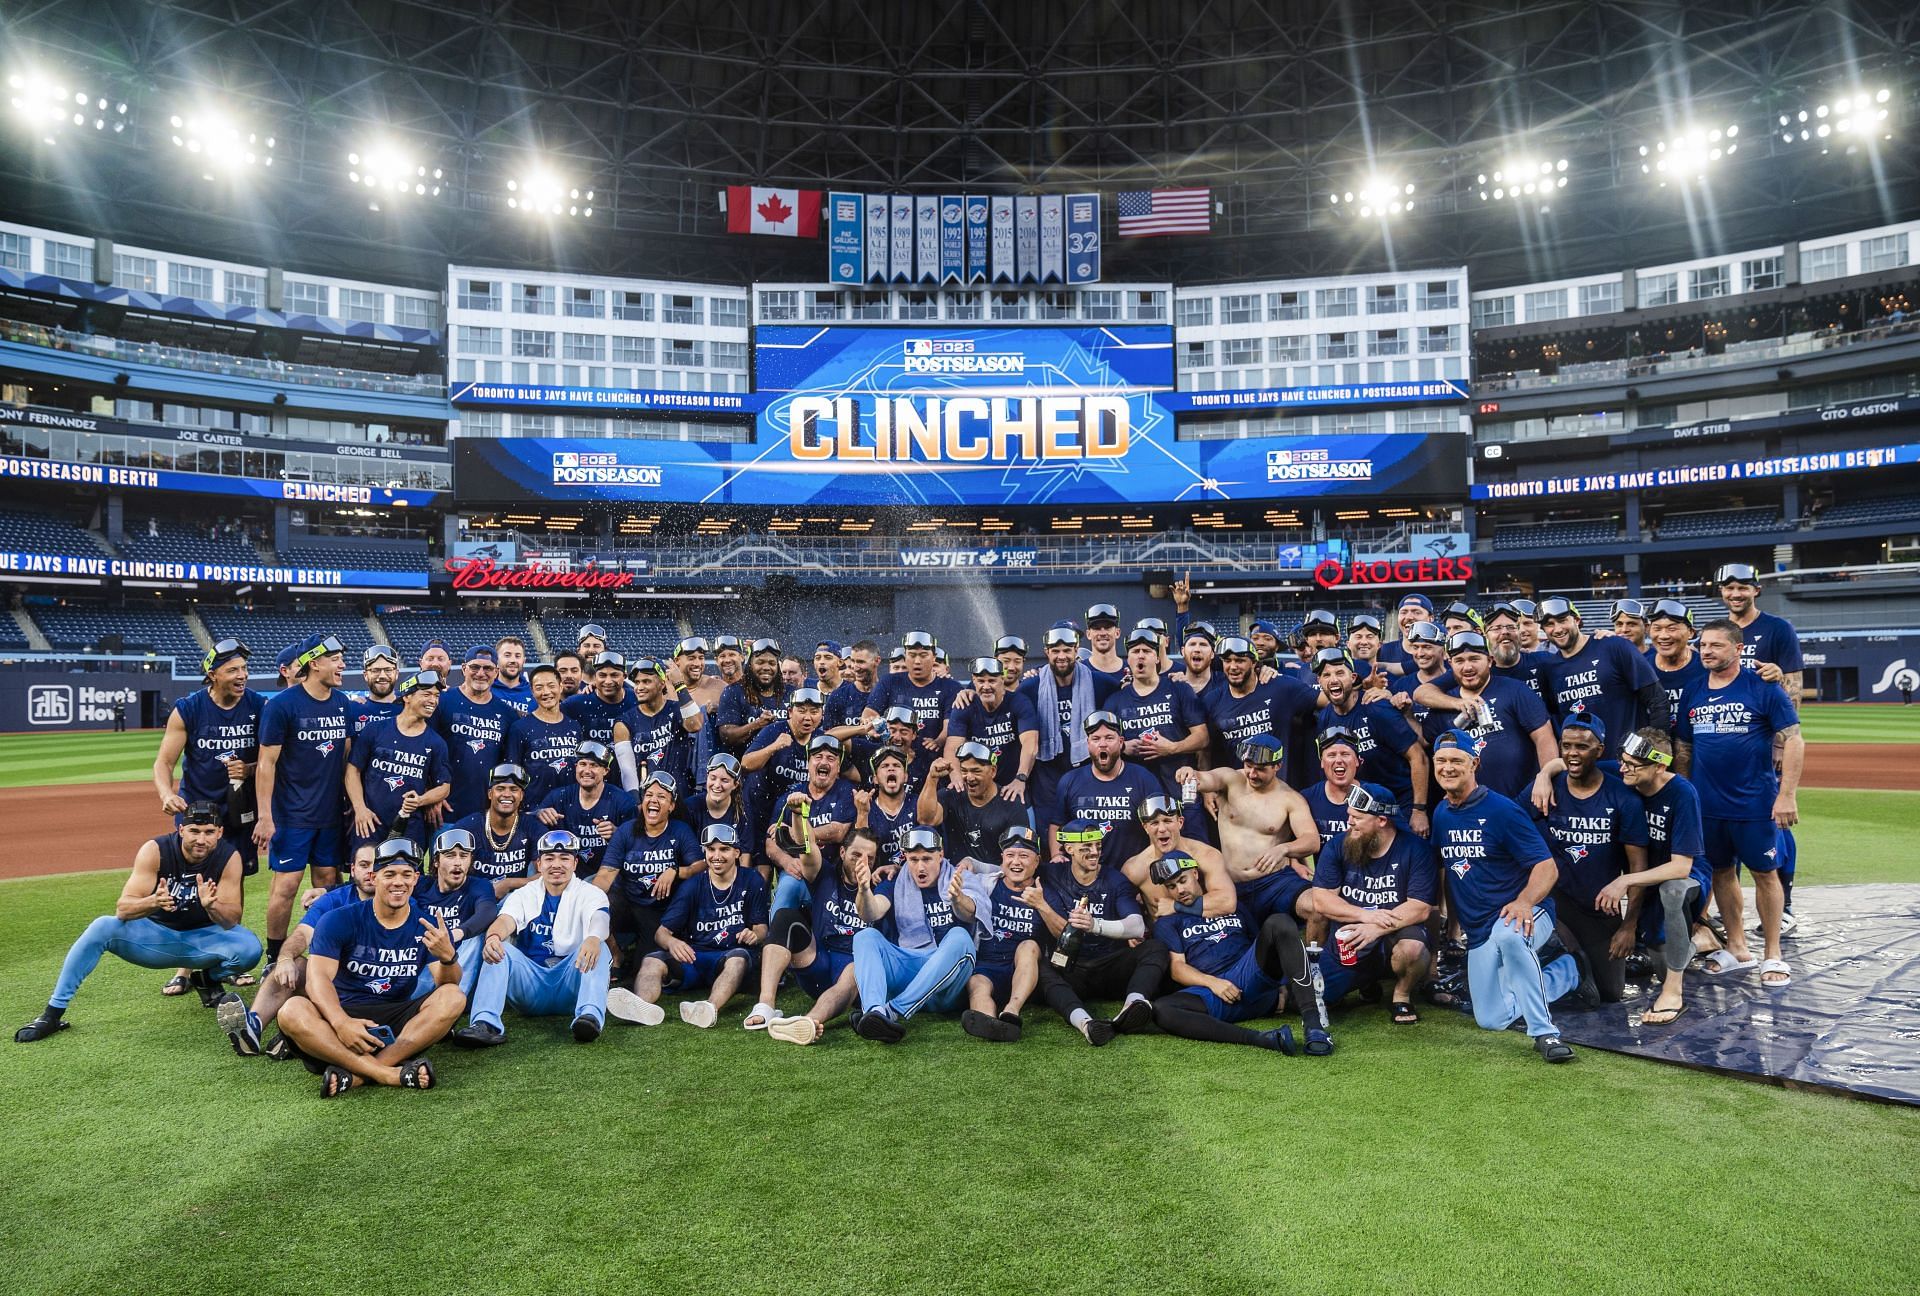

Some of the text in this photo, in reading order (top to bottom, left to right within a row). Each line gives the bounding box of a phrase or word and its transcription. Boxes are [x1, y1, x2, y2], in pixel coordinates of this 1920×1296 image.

[869, 226, 886, 238] 1985
[894, 227, 910, 238] 1989
[920, 228, 936, 239] 1991
[944, 228, 961, 239] 1992
[994, 227, 1012, 239] 2015
[1019, 227, 1036, 239] 2016
[1068, 232, 1098, 254] 32
[933, 342, 975, 352] 2023
[904, 356, 1024, 372] POSTSEASON
[472, 387, 742, 407] TORONTO BLUE JAYS HAVE CLINCHED A POSTSEASON BERTH
[1192, 384, 1452, 405] TORONTO BLUE JAYS HAVE CLINCHED A POSTSEASON BERTH
[1822, 402, 1899, 421] CITO GASTON
[29, 413, 97, 430] FERNANDEZ
[790, 396, 1129, 460] CLINCHED
[1674, 424, 1731, 438] DAVE STIEB
[177, 431, 242, 446] JOE CARTER
[337, 446, 401, 458] GEORGE BELL
[1292, 451, 1328, 461] 2023
[579, 456, 617, 465] 2023
[0, 459, 158, 486] POSTSEASON BERTH
[554, 467, 661, 483] POSTSEASON
[1268, 463, 1373, 479] POSTSEASON
[1488, 482, 1543, 497] TORONTO
[1548, 478, 1580, 493] BLUE
[1584, 476, 1615, 490] JAYS
[1620, 473, 1653, 488] HAVE
[1659, 466, 1726, 485] CLINCHED
[1731, 464, 1740, 478] A
[1746, 454, 1840, 476] POSTSEASON
[283, 482, 371, 504] CLINCHED
[901, 550, 1036, 567] WESTJET FLIGHT
[1007, 559, 1032, 567] DECK
[0, 554, 341, 584] UE JAYS HAVE CLINCHED A POSTSEASON BERTH
[445, 557, 633, 589] Budweiser
[1352, 556, 1472, 583] ROGERS
[1741, 644, 1756, 656] KE
[1565, 670, 1597, 687] TAKE
[79, 687, 137, 703] Here's
[1557, 684, 1603, 704] CTOBER
[912, 698, 938, 707] TAKE
[1137, 702, 1170, 716] TAKE
[1696, 703, 1744, 715] TORONTO
[772, 710, 787, 718] KE
[916, 709, 940, 719] OBER
[1237, 710, 1270, 726] TAKE
[1716, 712, 1752, 724] JAYS
[318, 716, 345, 727] TAKE
[471, 716, 501, 730] TAKE
[1122, 714, 1173, 730] OCTOBER
[219, 725, 254, 737] TAKE
[298, 728, 346, 740] OCTOBER
[451, 724, 501, 742] OCTOBER
[1354, 727, 1371, 739] KE
[1468, 721, 1504, 738] OBER
[197, 738, 255, 749] OCTOBER
[549, 737, 577, 747] TAKE
[394, 750, 427, 767] TAKE
[531, 750, 578, 760] OCTOBE
[372, 759, 423, 779] OCTOBER
[776, 766, 809, 782] OCTOB
[1096, 796, 1130, 807] TAKE
[1076, 810, 1132, 820] OCTOBER
[579, 825, 599, 835] TAK
[1328, 820, 1350, 832] TA
[1569, 817, 1611, 830] TAKE
[1448, 830, 1482, 842] TAKE
[494, 849, 525, 862] TAKE
[644, 849, 674, 861] TAKE
[1441, 846, 1487, 858] CTOBER
[473, 860, 525, 875] OCTOBER
[1364, 875, 1395, 890] TAKE
[1342, 885, 1399, 906] OCTOBER
[716, 901, 744, 918] TAKE
[843, 900, 856, 913] TA
[999, 904, 1034, 919] TAKE
[826, 900, 868, 928] OCTOBE
[697, 914, 744, 932] OCTOBER
[993, 916, 1033, 933] TOBER
[1182, 918, 1242, 938] OCTOBER
[378, 948, 418, 962] TAKE
[347, 961, 418, 978] OCTOBER
